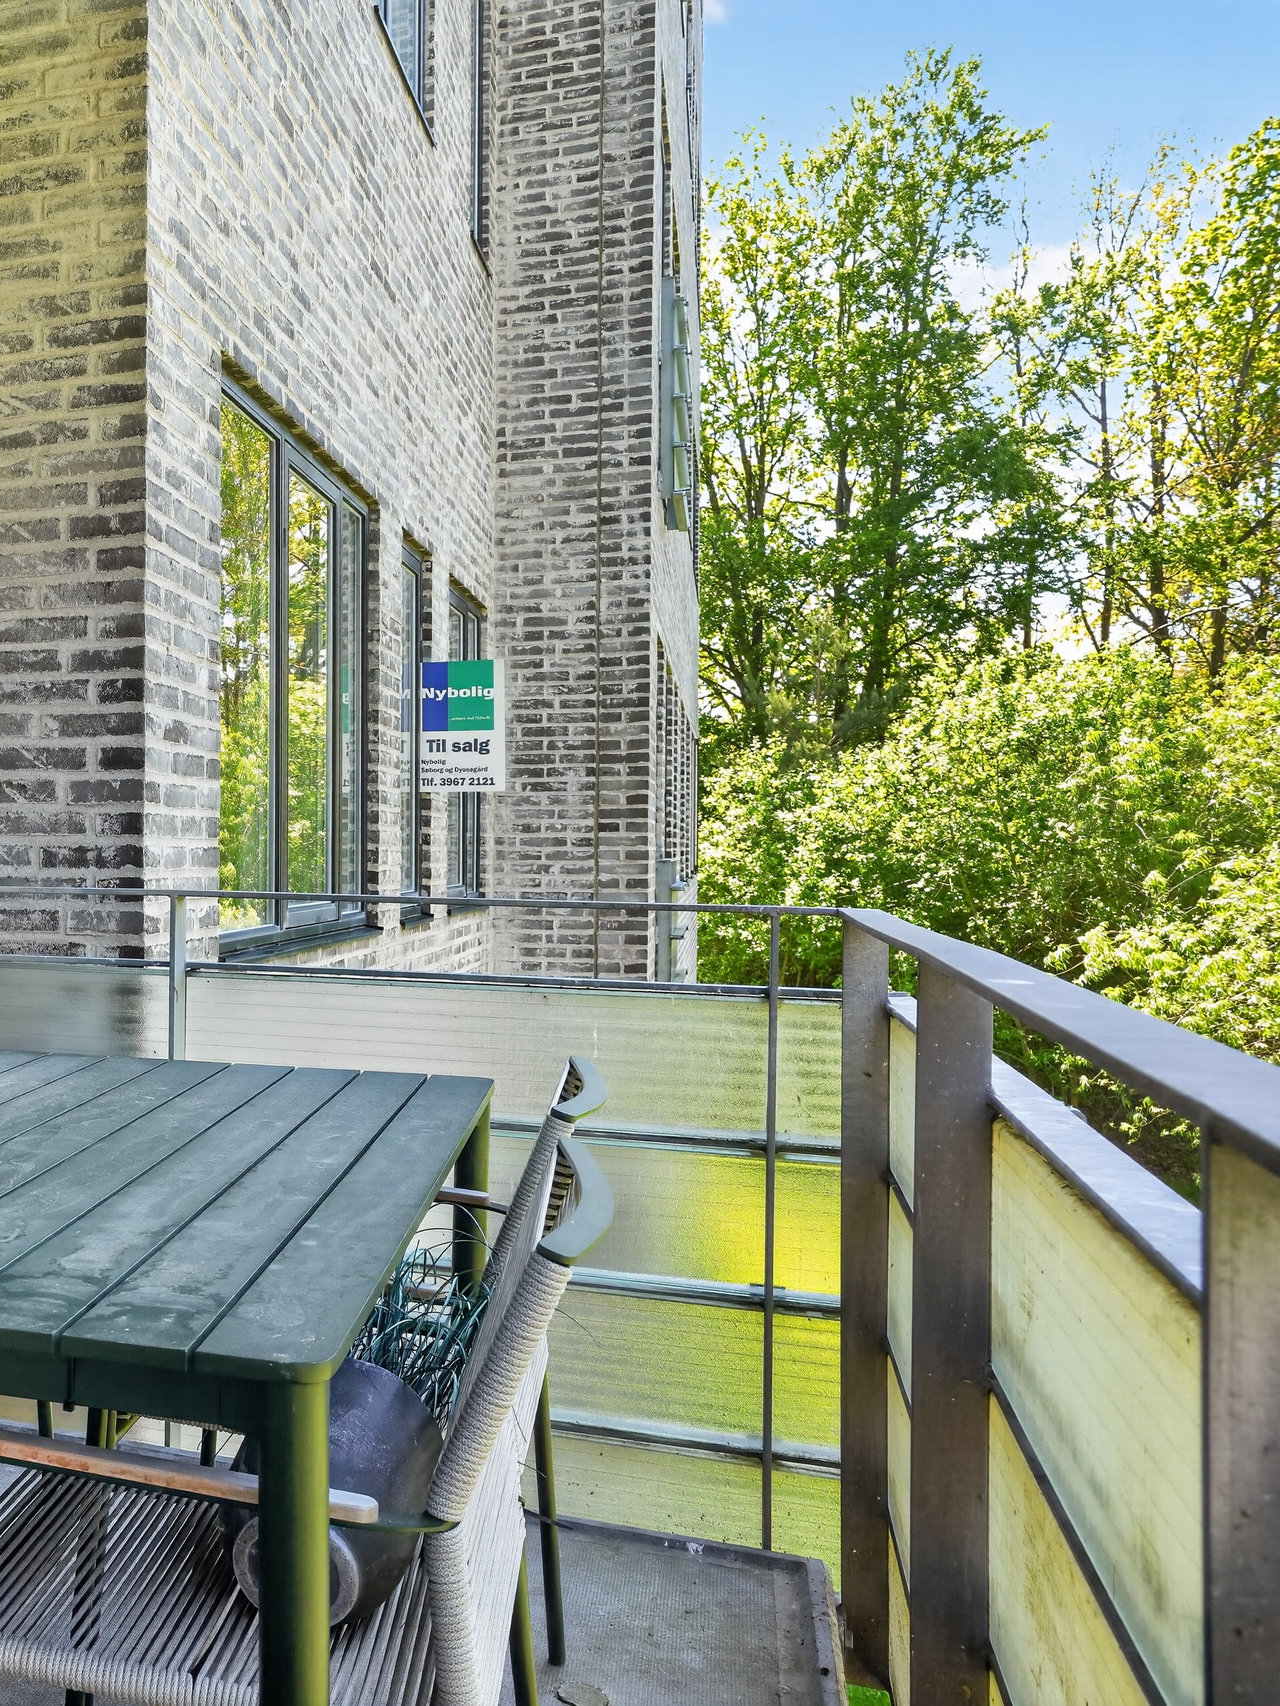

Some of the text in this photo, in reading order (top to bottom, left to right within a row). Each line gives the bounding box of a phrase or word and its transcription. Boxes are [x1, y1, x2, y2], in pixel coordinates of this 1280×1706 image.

[420, 686, 494, 701] Nybolig
[426, 738, 491, 755] Til salg
[421, 776, 496, 787] Tlf. 3967 2121
